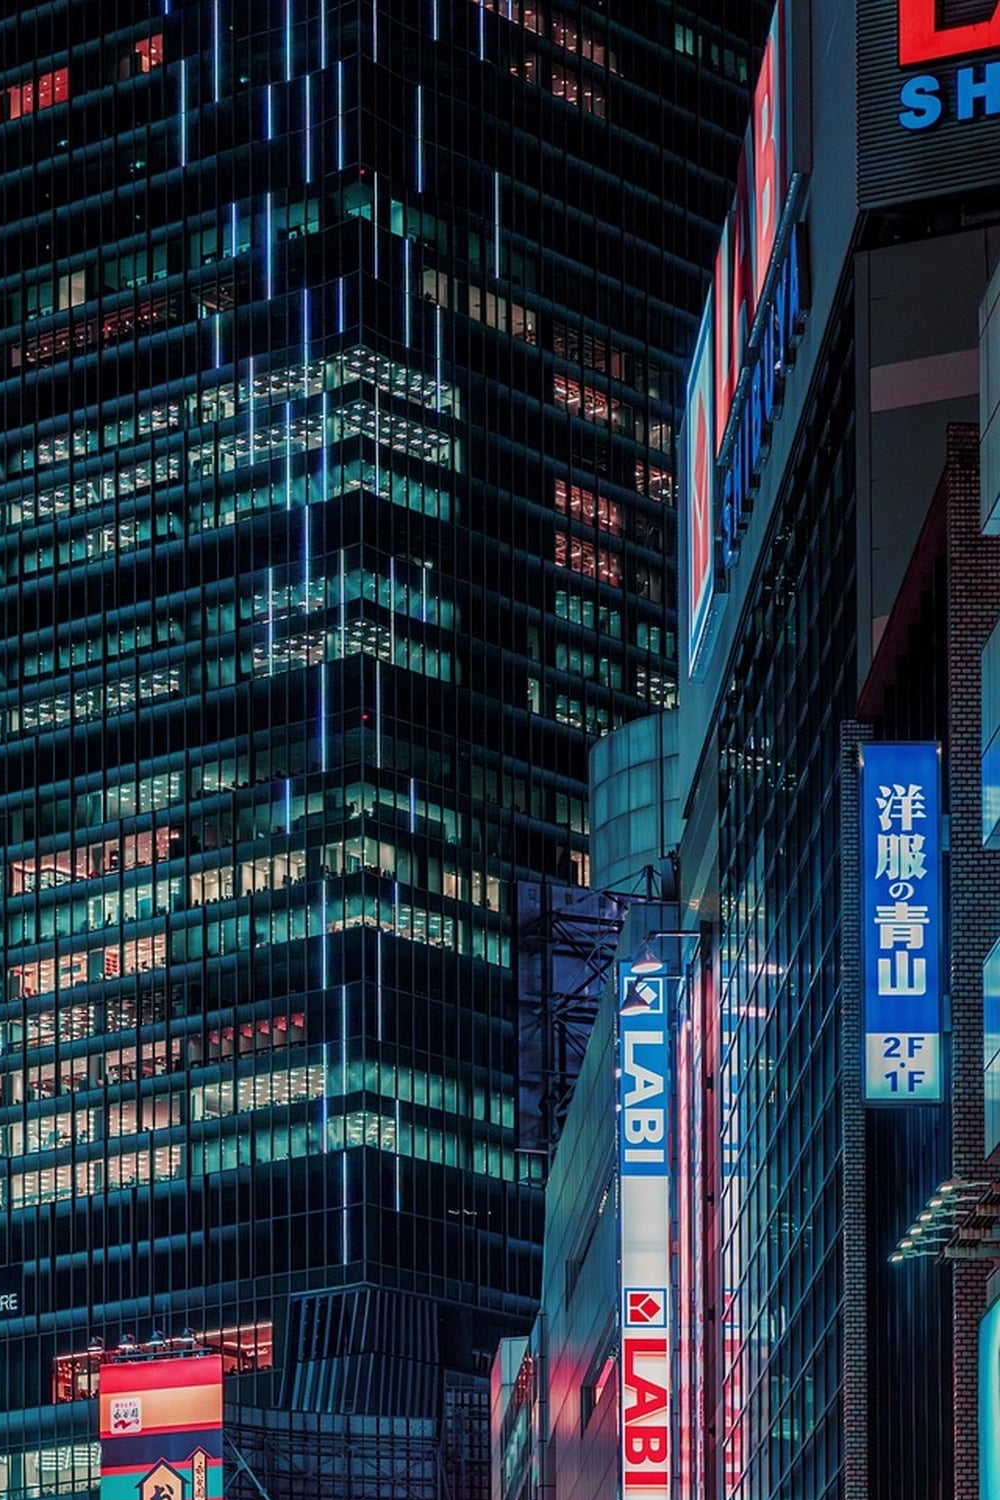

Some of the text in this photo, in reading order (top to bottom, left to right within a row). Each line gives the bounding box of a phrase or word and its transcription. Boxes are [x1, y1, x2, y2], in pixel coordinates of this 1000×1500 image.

[873, 783, 930, 997] 洋服の青山
[623, 1030, 665, 1165] LABI
[882, 1037, 925, 1058] 2F
[884, 1071, 925, 1093] 1F
[624, 1337, 669, 1490] LABI
